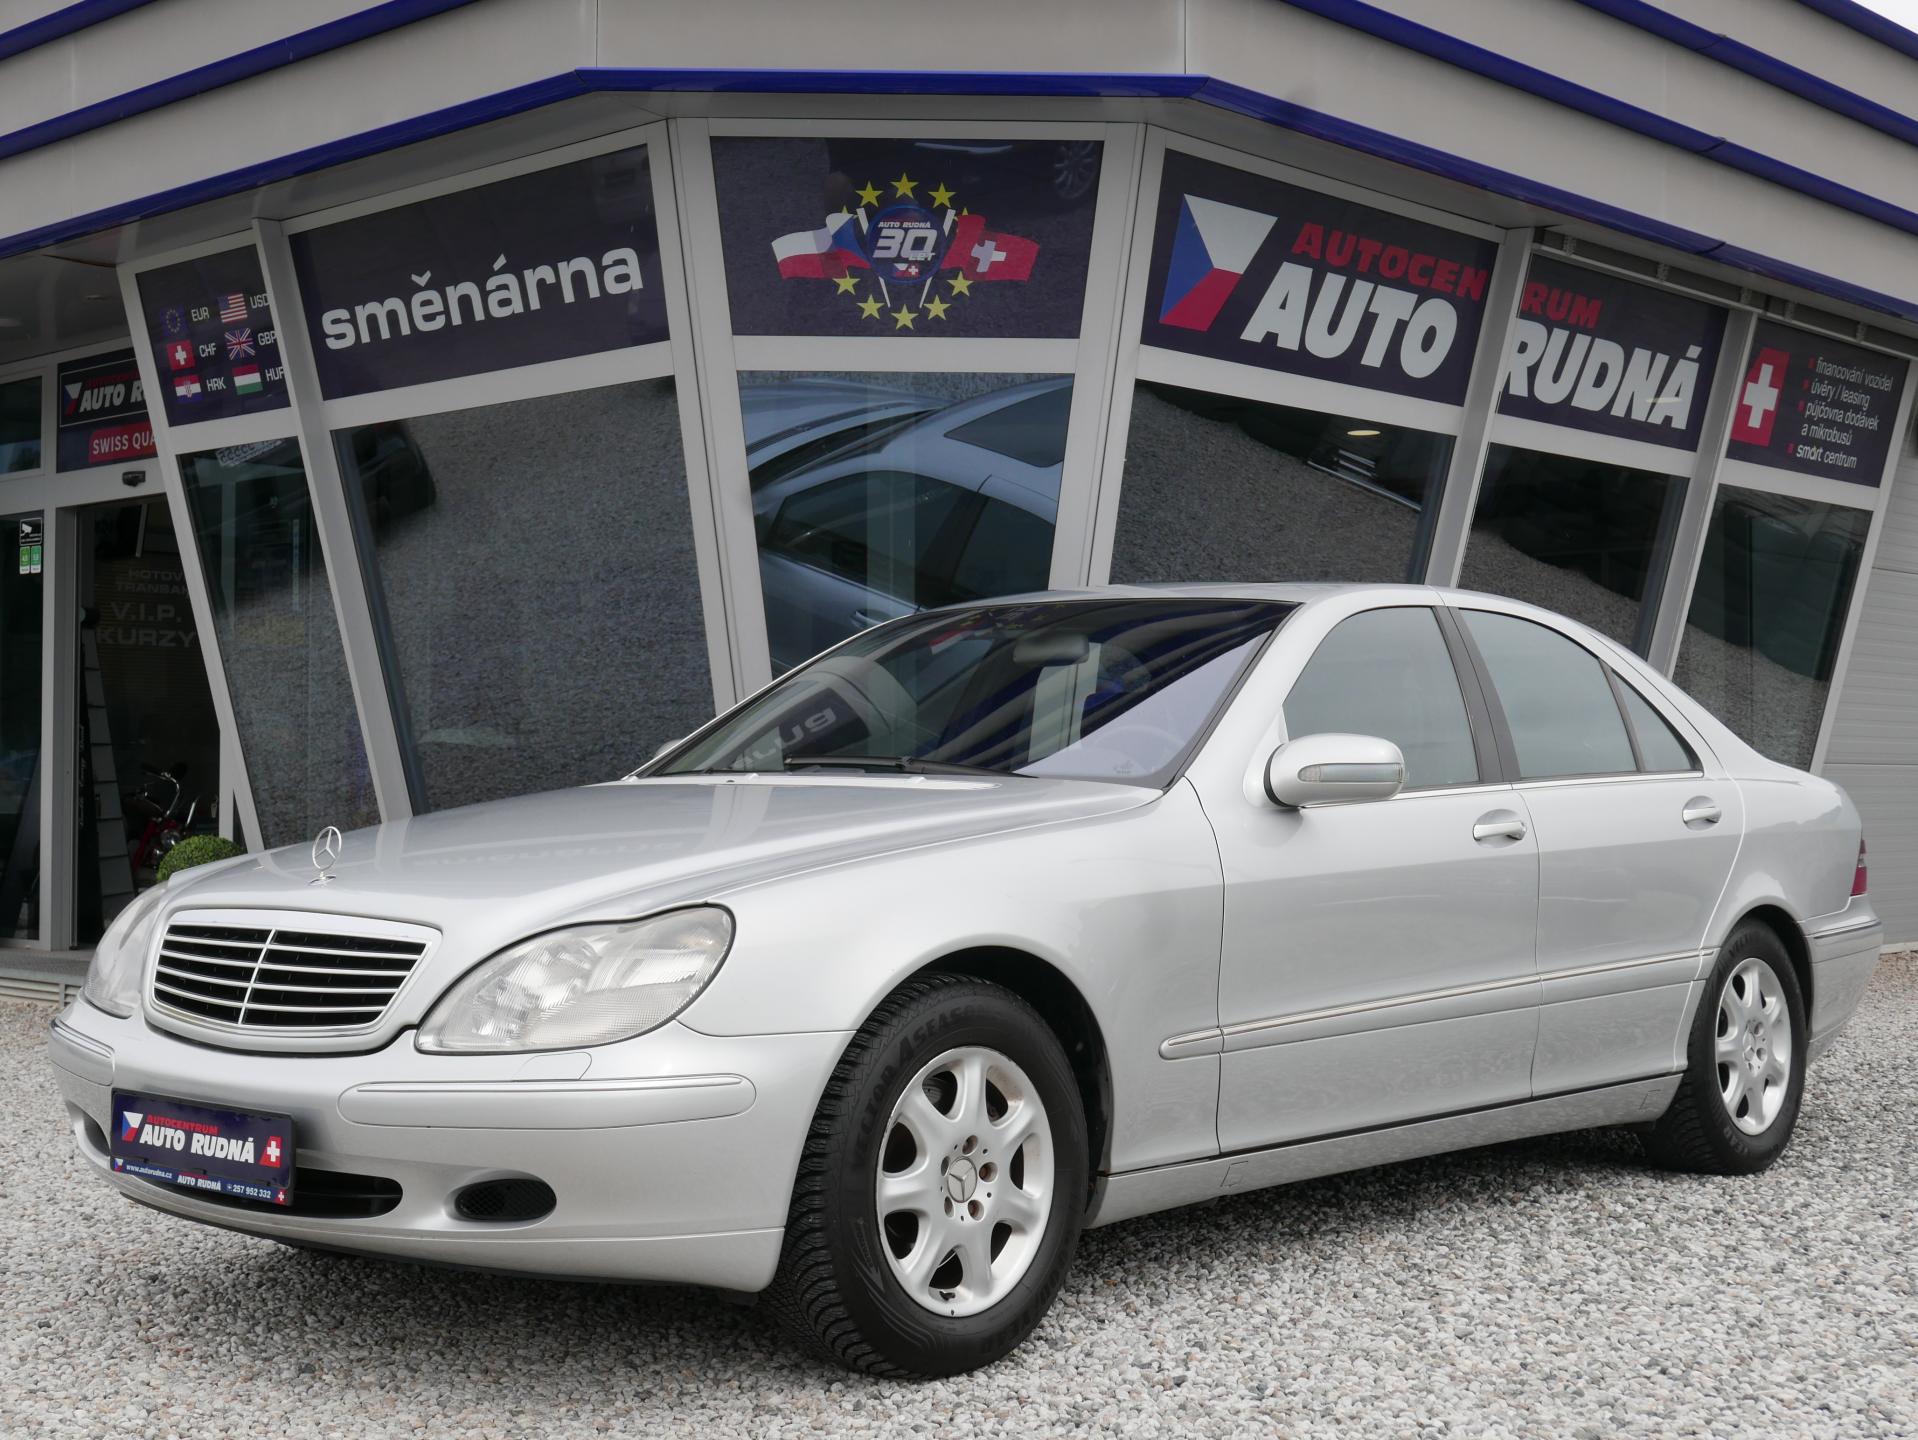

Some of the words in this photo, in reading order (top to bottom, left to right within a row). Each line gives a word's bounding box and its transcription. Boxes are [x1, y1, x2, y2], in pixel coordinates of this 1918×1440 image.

[872, 228, 938, 258] 30
[250, 293, 269, 309] USD
[321, 247, 644, 350] směnárna
[191, 307, 210, 321] EUR
[257, 330, 277, 346] GBP
[1240, 261, 1458, 379] AUTO
[1501, 317, 1702, 430] RUDNÁ
[199, 342, 217, 357] CHF
[206, 377, 227, 392] HRK
[265, 366, 285, 382] HUF
[1816, 357, 1864, 382] financování
[1865, 372, 1893, 392] vozidel
[79, 383, 122, 413] AUTO
[1841, 385, 1870, 409] leasing
[1801, 423, 1807, 435] a
[1845, 409, 1879, 430] dodávek
[93, 434, 129, 455] SWISS
[1796, 444, 1821, 461] smart
[1824, 451, 1857, 468] centrum
[146, 1114, 218, 1135] AUTOCENTRUM
[139, 1124, 186, 1151] AUTO
[190, 1133, 255, 1164] RUDNÁ
[177, 1175, 195, 1186] AUTO
[197, 1179, 221, 1190] RUDNÁ
[233, 1184, 244, 1194] 257
[245, 1187, 258, 1196] 952
[258, 1190, 272, 1199] 332
